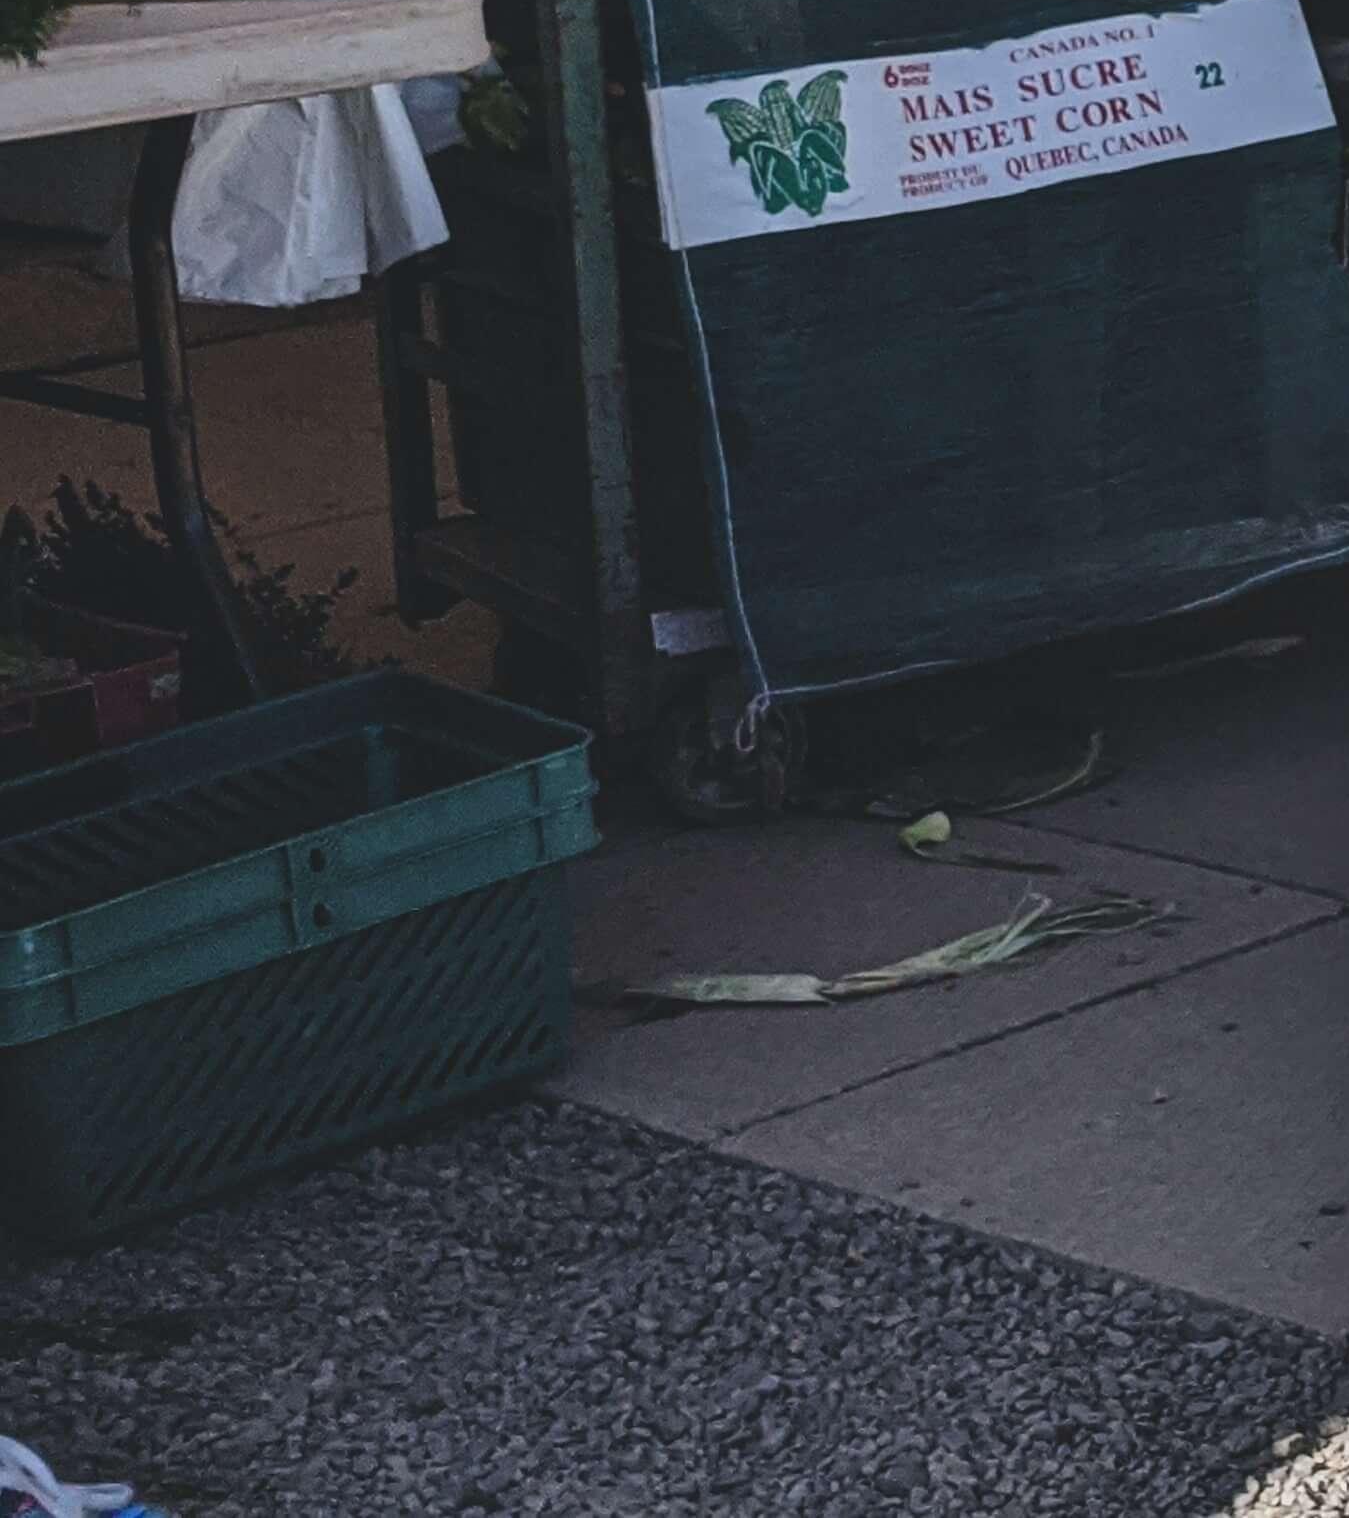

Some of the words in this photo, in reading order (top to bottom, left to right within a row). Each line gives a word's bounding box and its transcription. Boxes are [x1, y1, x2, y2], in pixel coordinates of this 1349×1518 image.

[1010, 34, 1099, 63] CANADA
[884, 63, 901, 89] 6
[900, 84, 994, 123] MAIS
[1018, 54, 1148, 104] SUCRE
[1195, 63, 1225, 89] 22
[909, 115, 1038, 164] SWEET
[1056, 90, 1163, 134] CORN
[1102, 124, 1190, 157] CANADA
